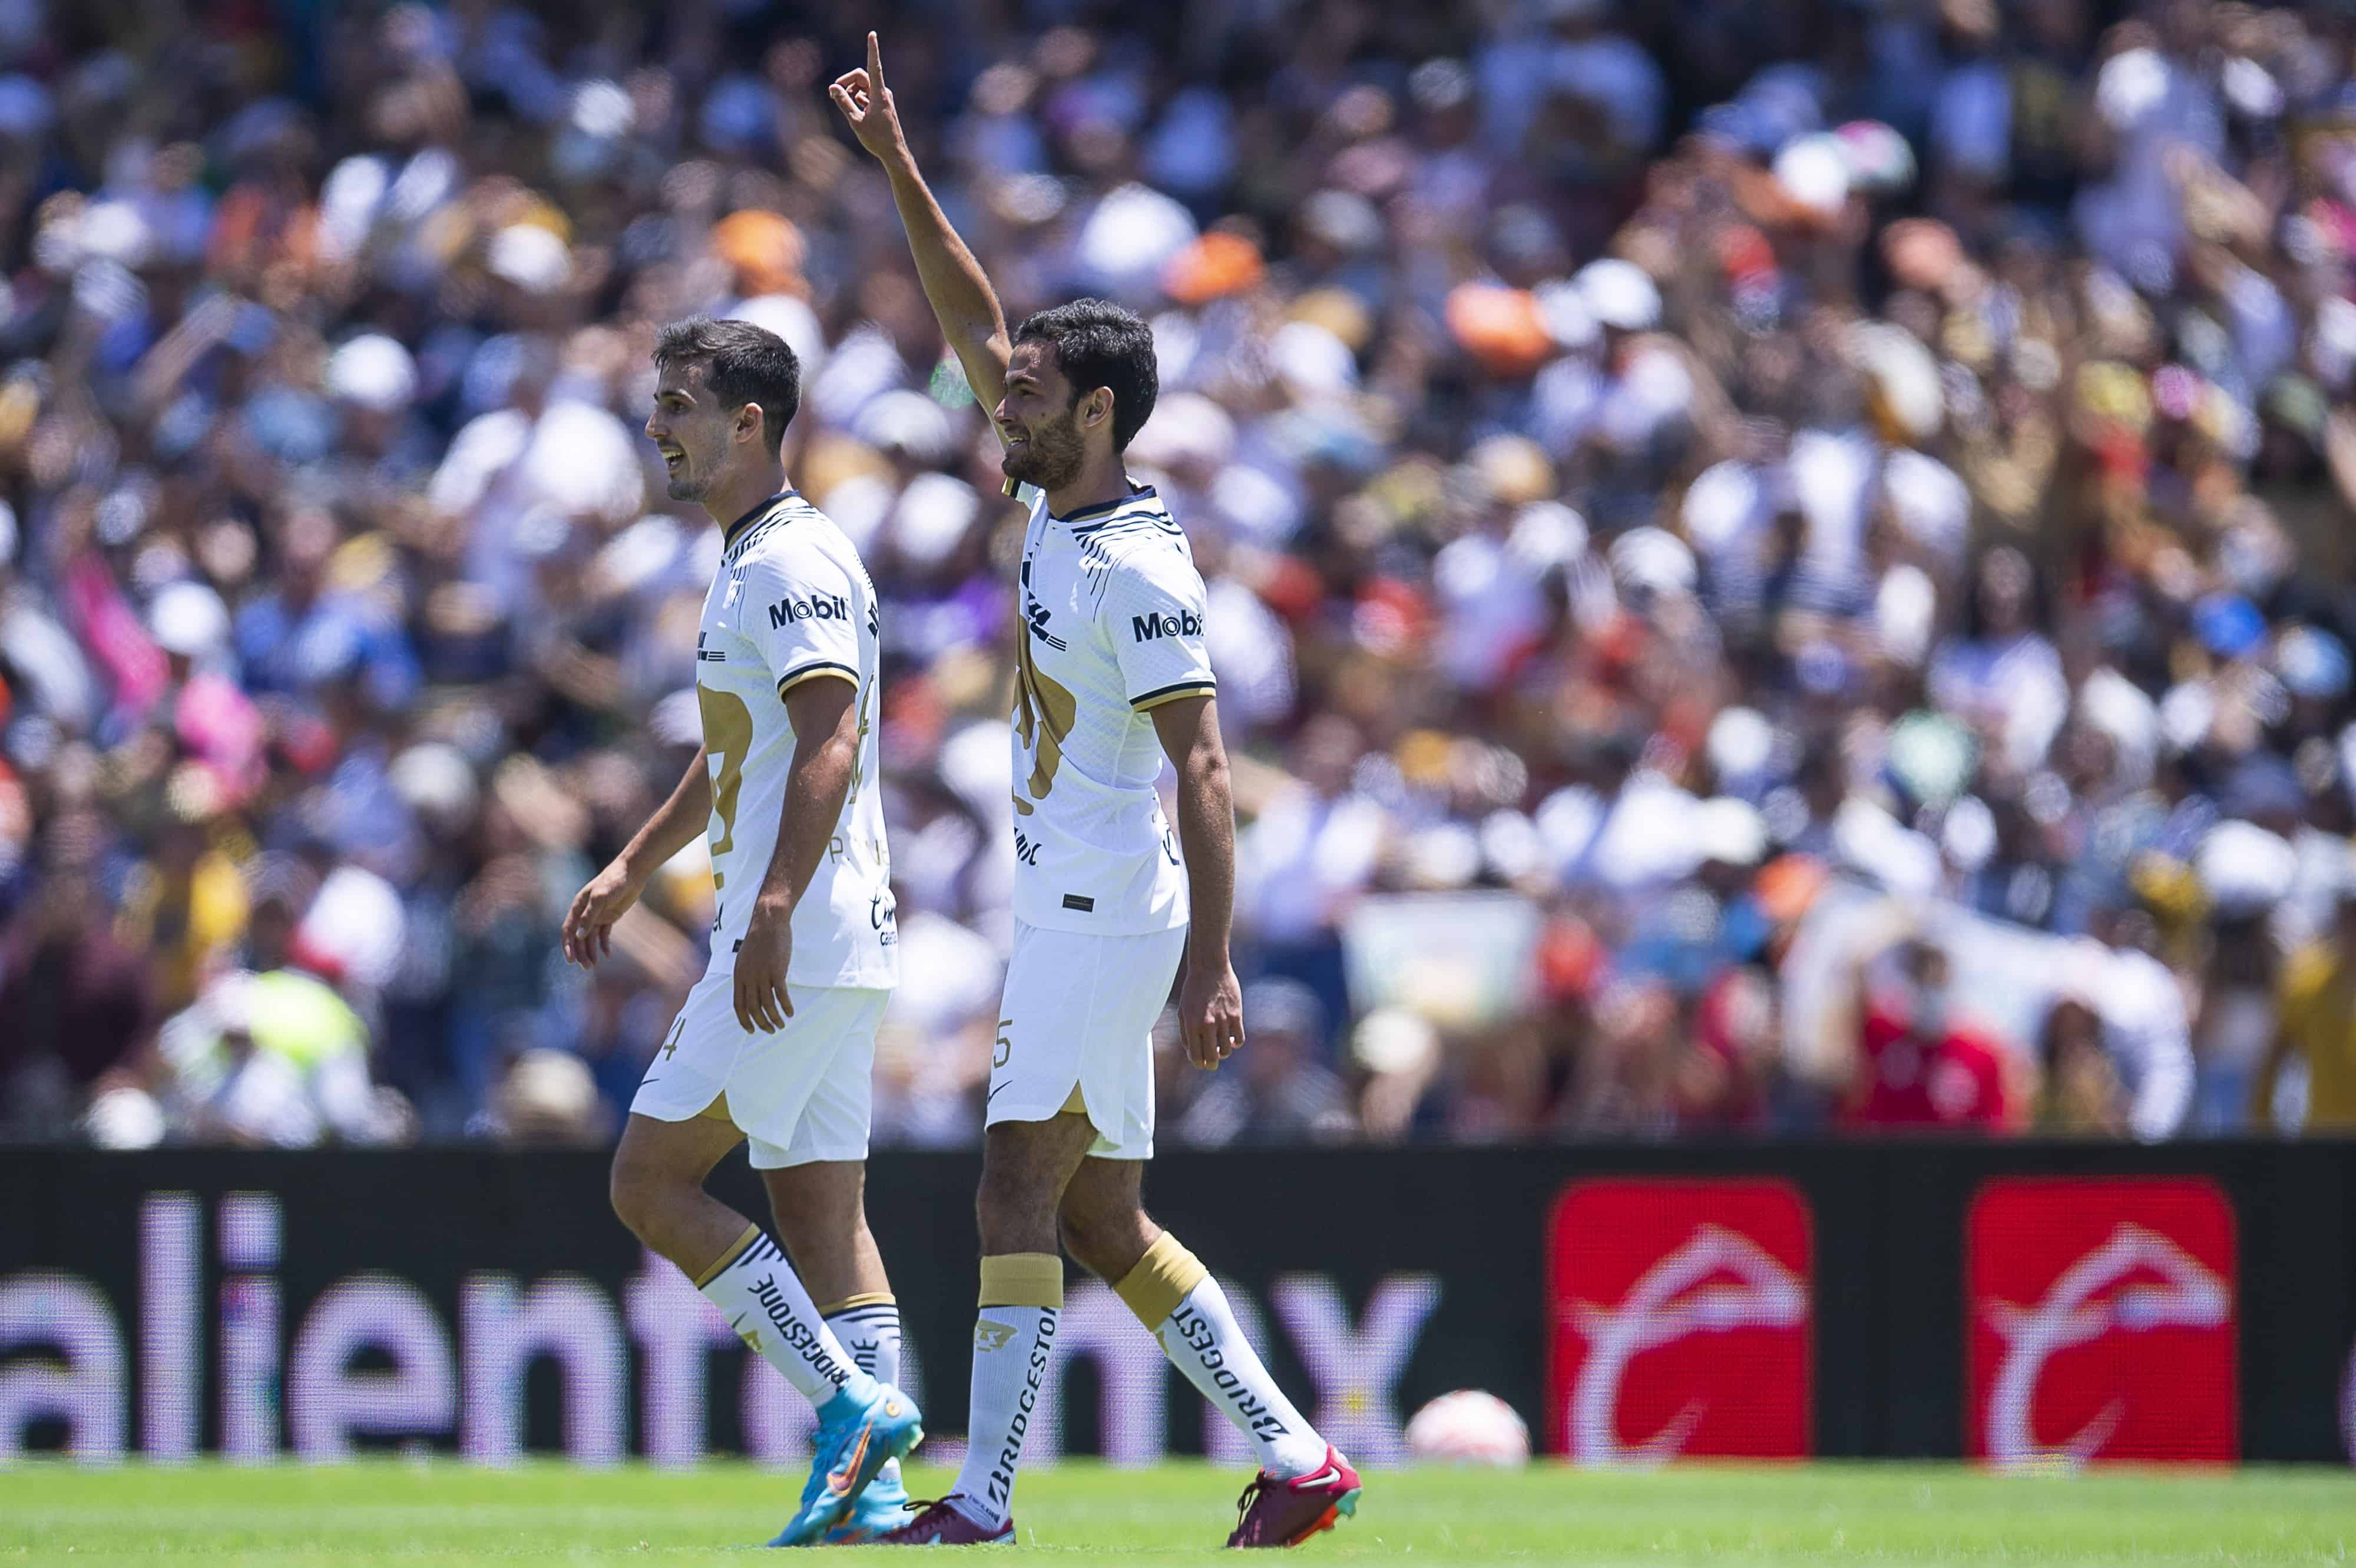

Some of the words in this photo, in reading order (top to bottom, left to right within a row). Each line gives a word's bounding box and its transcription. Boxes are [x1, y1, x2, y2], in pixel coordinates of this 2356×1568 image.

[769, 596, 848, 630] Mobil
[1132, 609, 1203, 643] Mobi
[994, 1019, 1012, 1068] 5
[747, 1272, 850, 1394] RIDGESTONE
